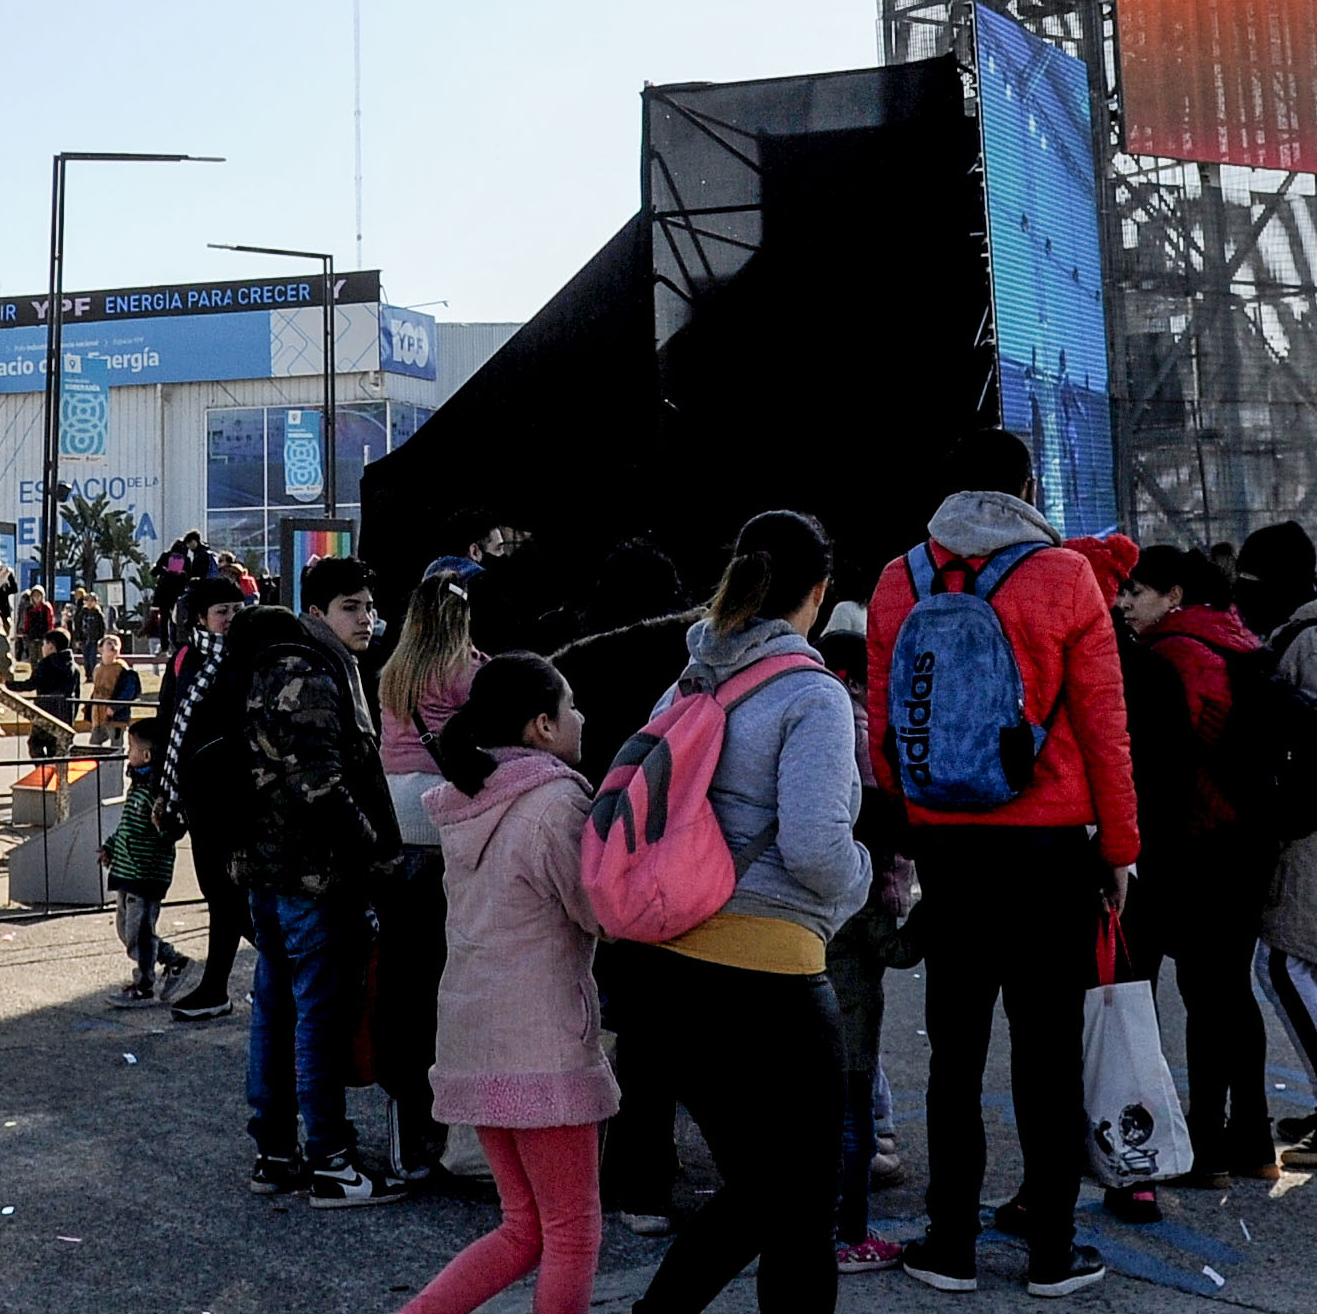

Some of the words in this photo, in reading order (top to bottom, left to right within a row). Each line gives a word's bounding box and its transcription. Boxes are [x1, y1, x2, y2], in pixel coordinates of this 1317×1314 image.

[32, 297, 91, 320] YPF
[105, 289, 183, 314] ENERGÍA
[188, 288, 233, 309] PARA
[238, 283, 311, 304] CRECER
[19, 477, 126, 504] ESACIO
[127, 476, 142, 487] DE
[899, 650, 935, 786] adidas
